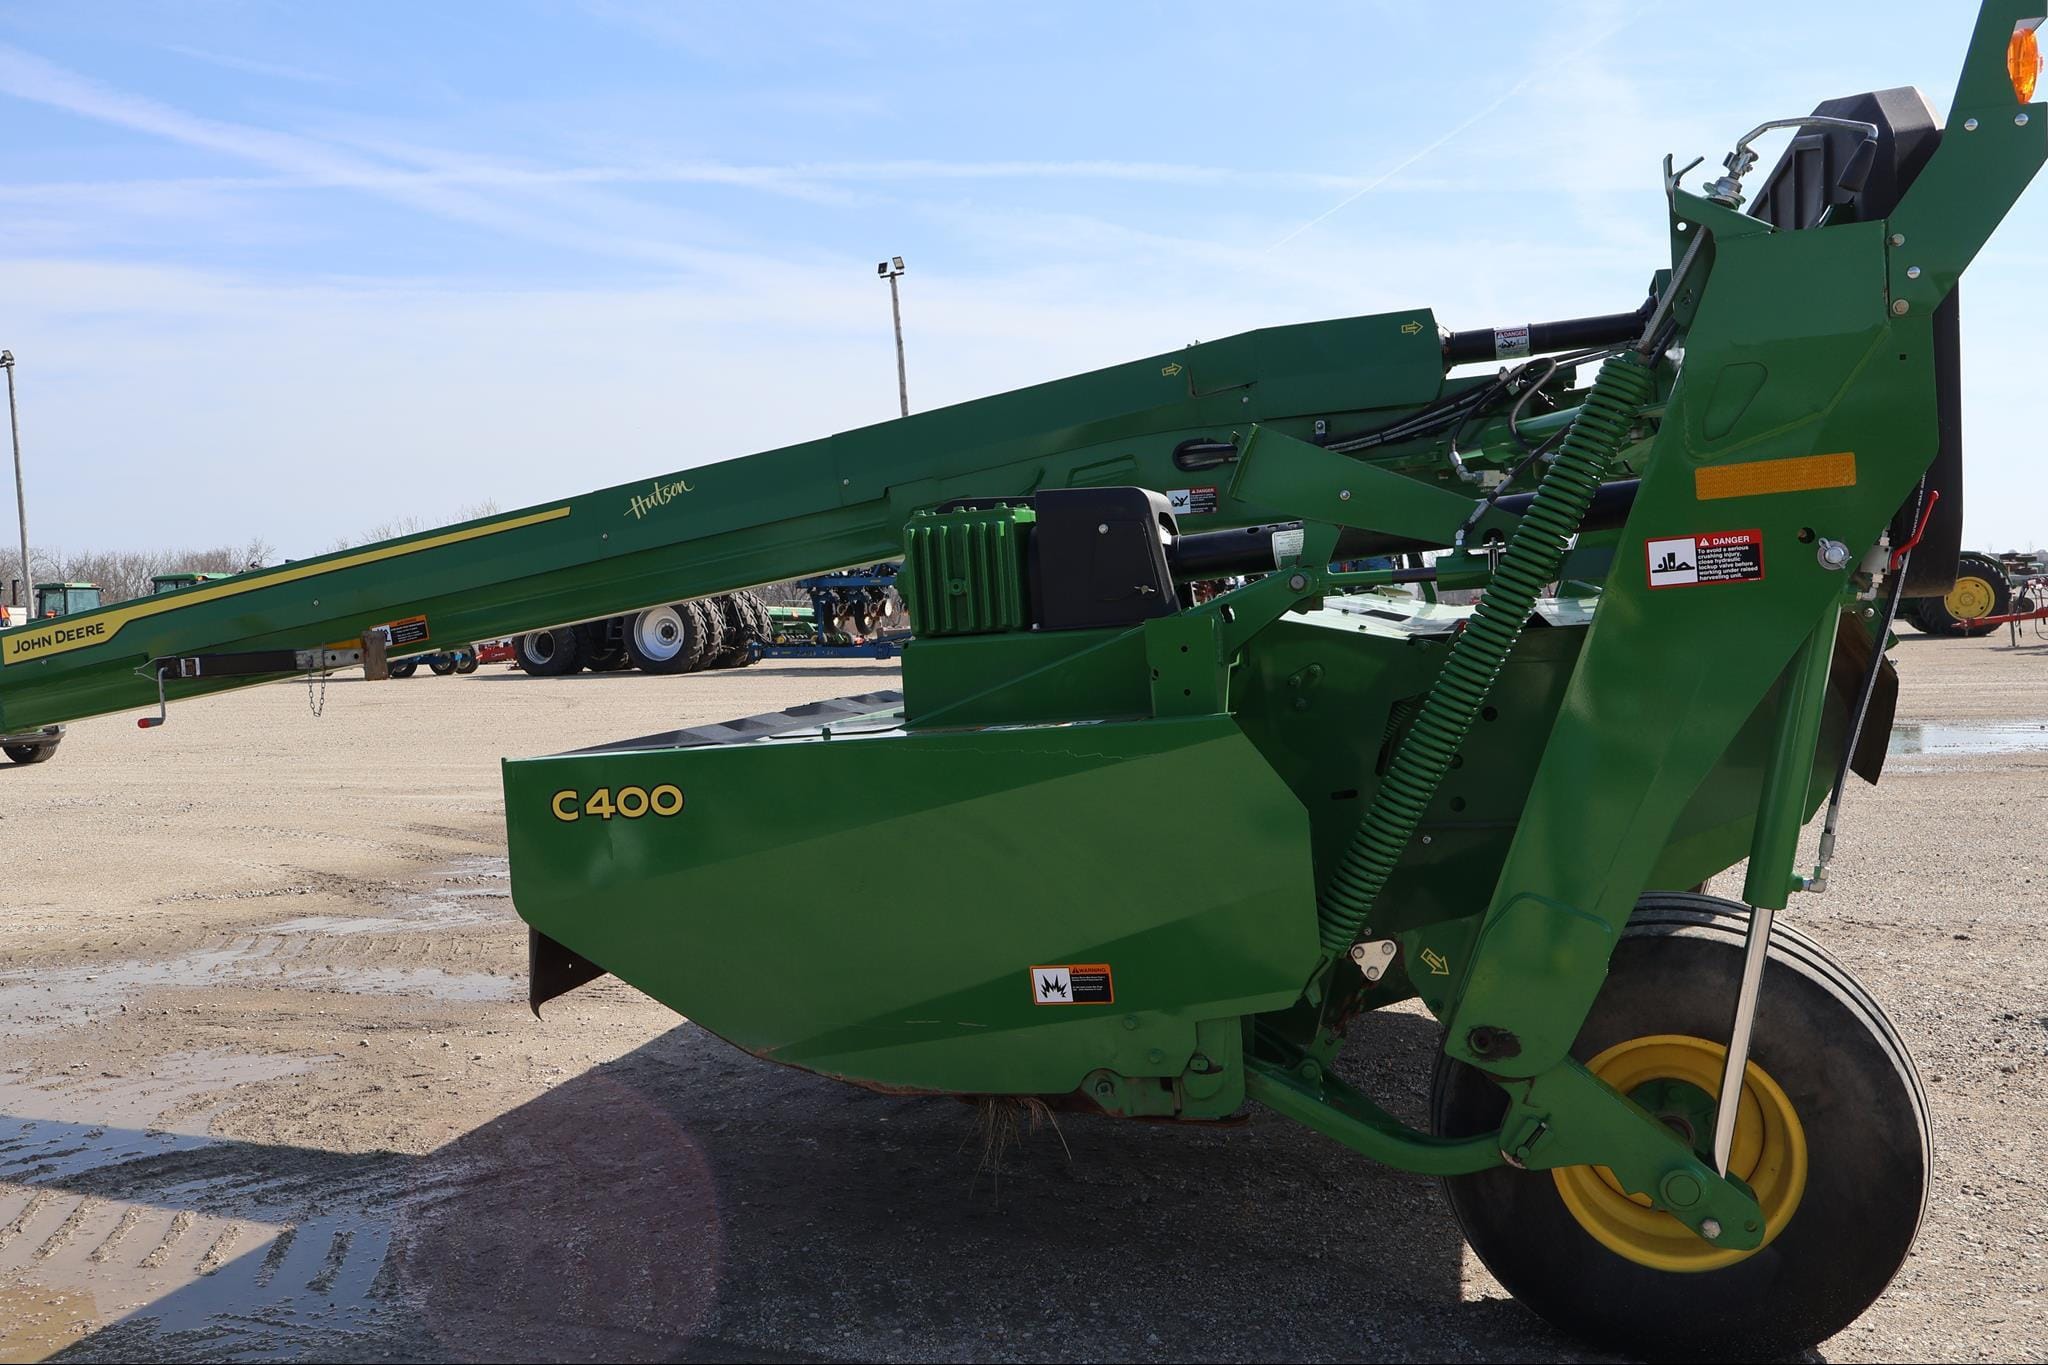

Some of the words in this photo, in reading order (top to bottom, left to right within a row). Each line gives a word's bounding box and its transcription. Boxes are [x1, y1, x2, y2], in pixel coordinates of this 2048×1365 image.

[624, 481, 695, 519] Hutson
[1712, 535, 1750, 545] DANGER
[13, 635, 52, 654] JOHN
[54, 623, 105, 644] DEERE
